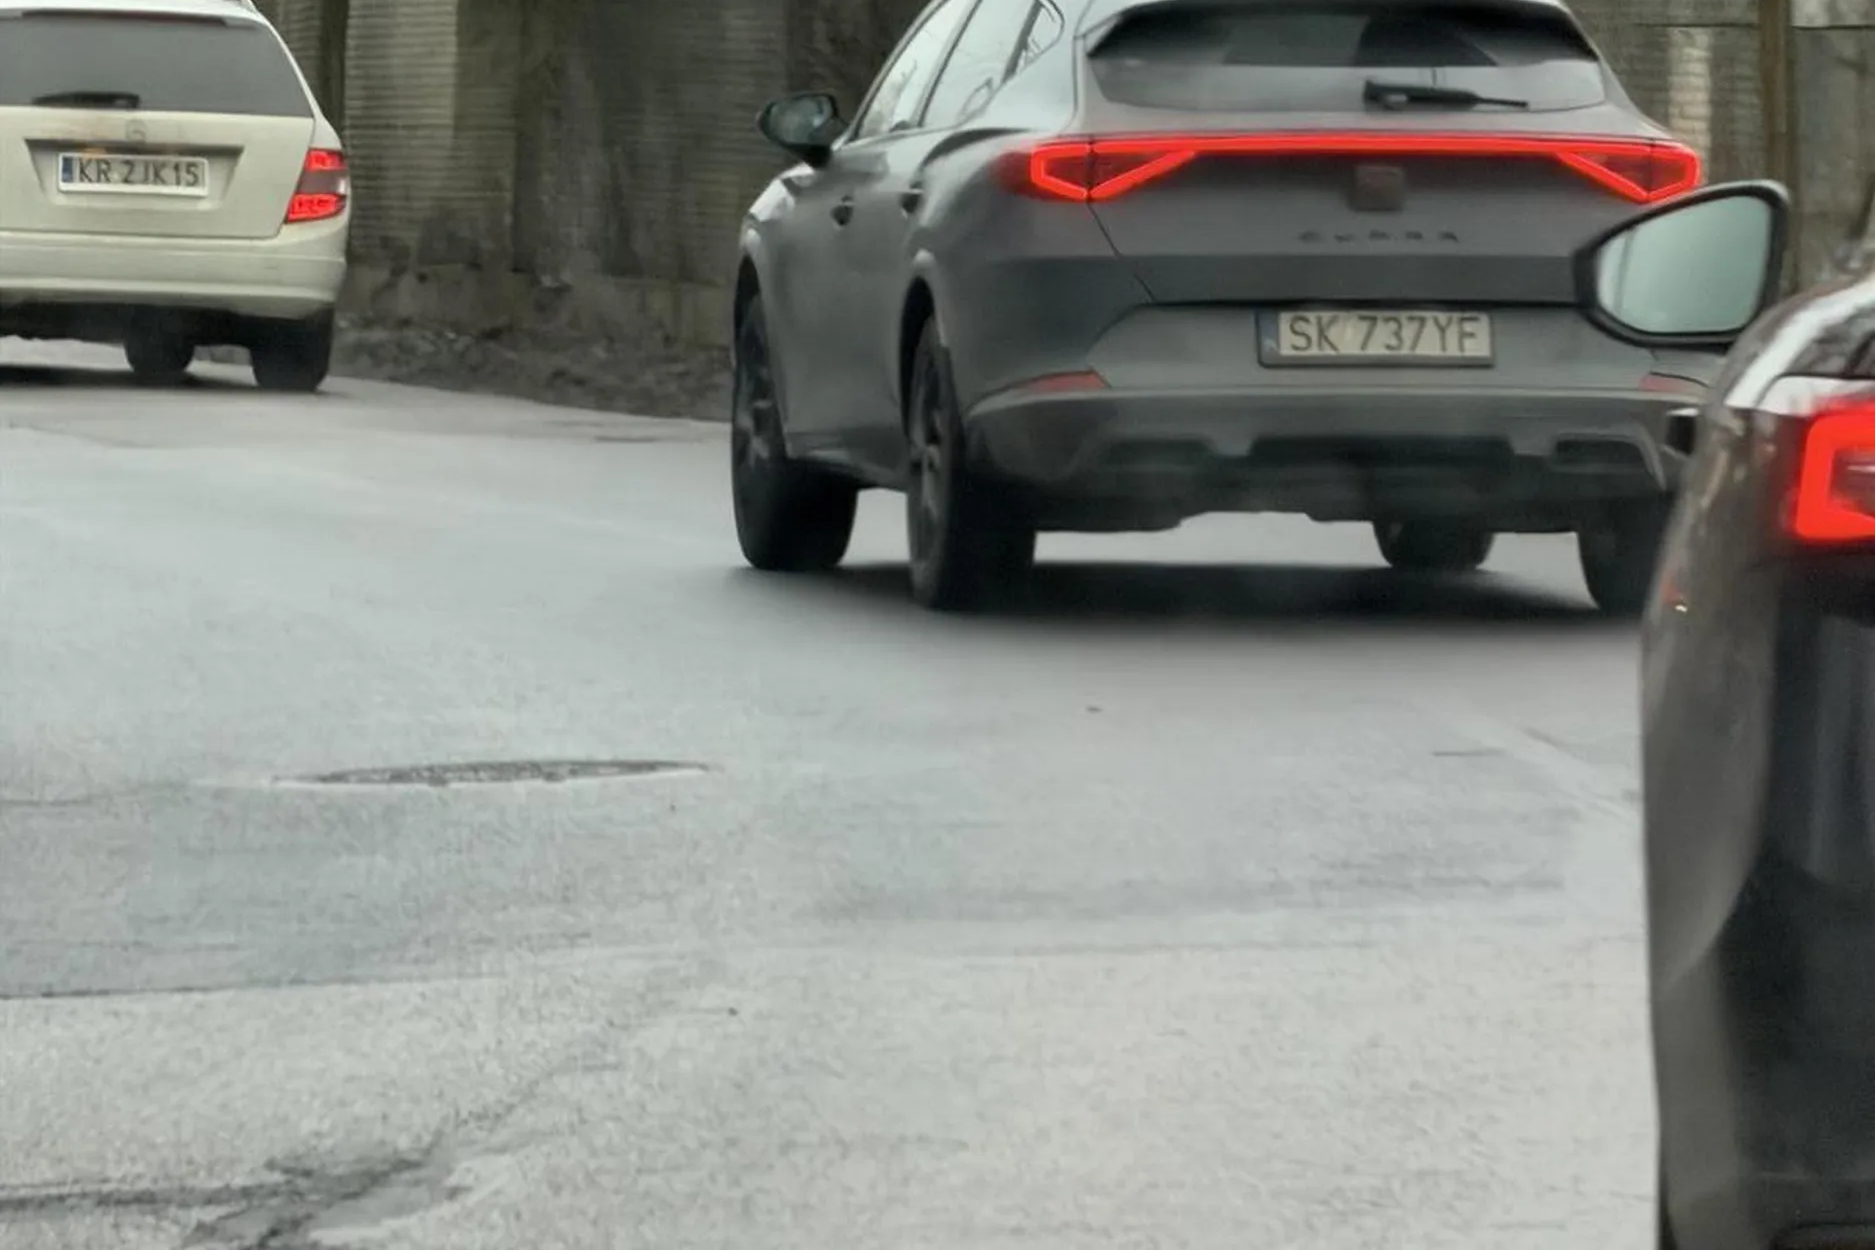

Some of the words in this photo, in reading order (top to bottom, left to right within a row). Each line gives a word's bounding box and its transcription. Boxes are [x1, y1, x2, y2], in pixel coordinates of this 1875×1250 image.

[78, 157, 112, 184] KR
[1289, 314, 1340, 354] SK
[1357, 314, 1481, 354] 737YF
